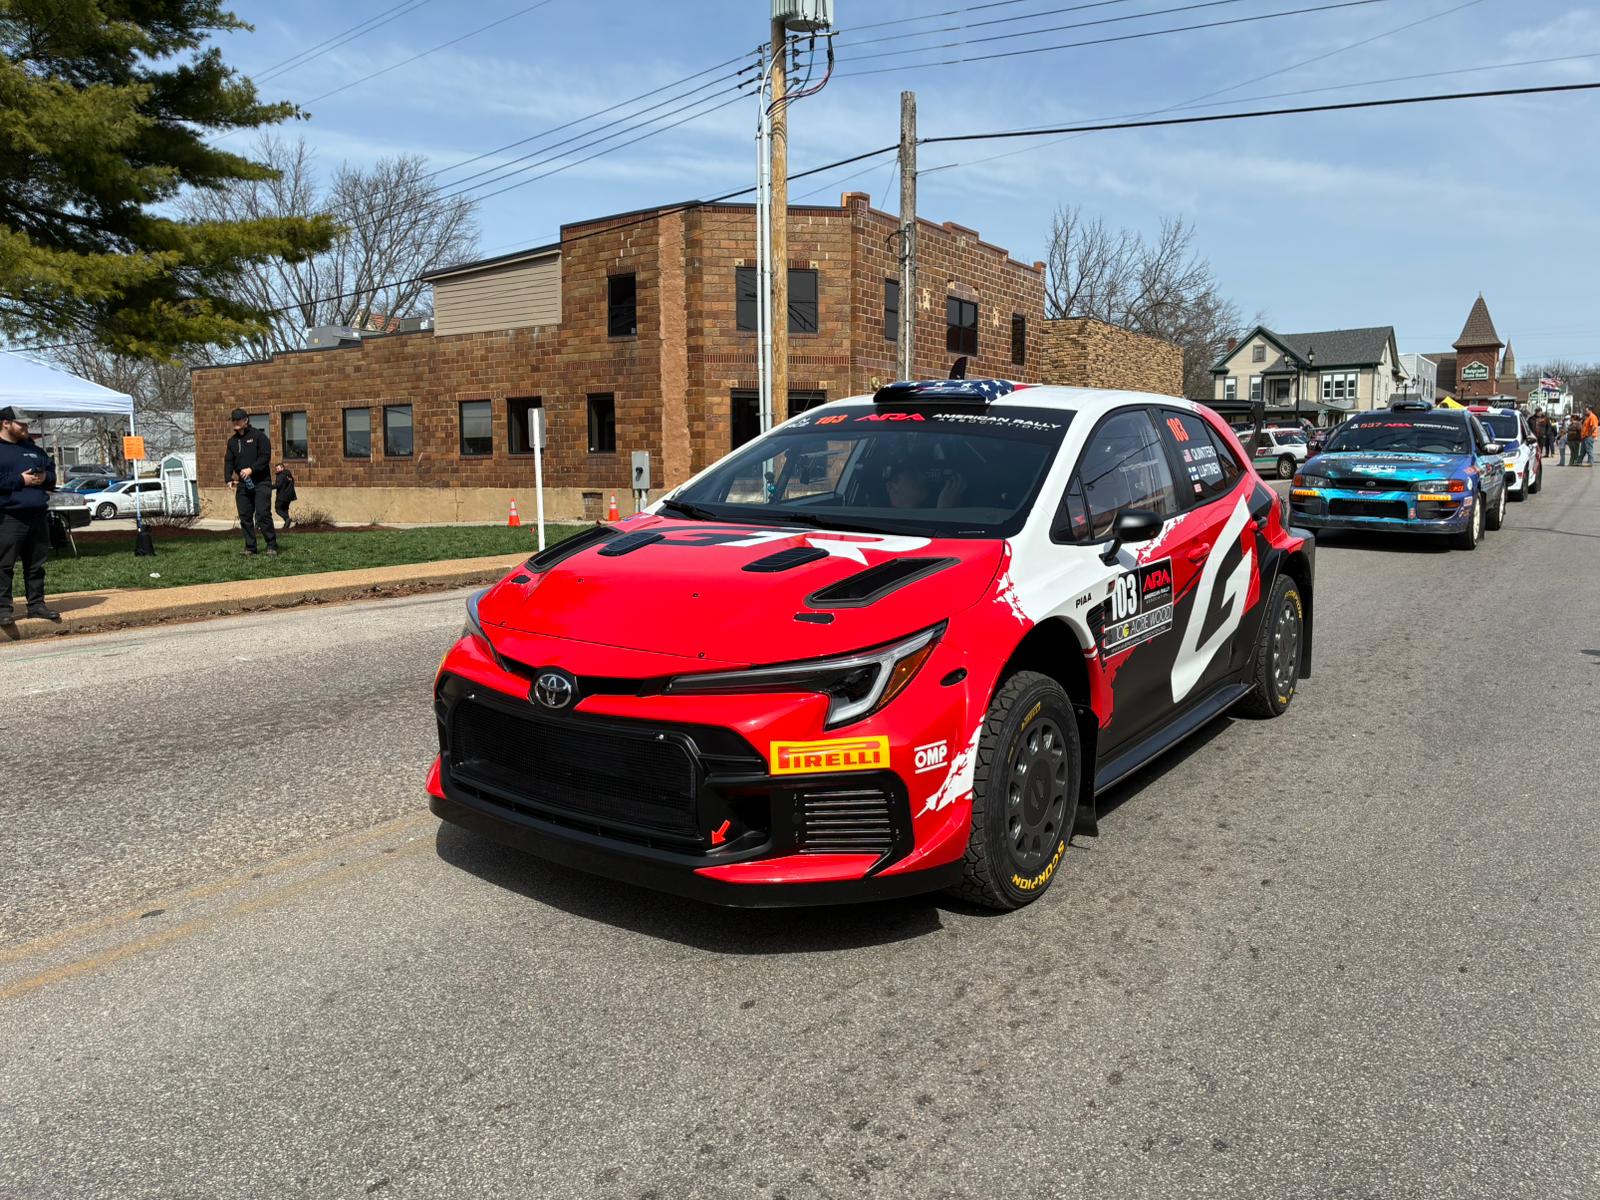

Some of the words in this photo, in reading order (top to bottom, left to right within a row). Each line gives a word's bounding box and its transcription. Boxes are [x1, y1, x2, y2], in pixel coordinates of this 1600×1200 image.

[815, 414, 848, 425] 103
[932, 413, 1009, 423] AMERICAN
[1012, 419, 1062, 429] RALLY
[1166, 417, 1190, 442] 103
[1076, 593, 1092, 608] PIAA
[1111, 573, 1138, 622] 103
[1149, 606, 1171, 627] WOOD
[777, 741, 881, 769] PIRELLI
[914, 743, 948, 768] OMP
[1011, 840, 1065, 890] SCORPION
